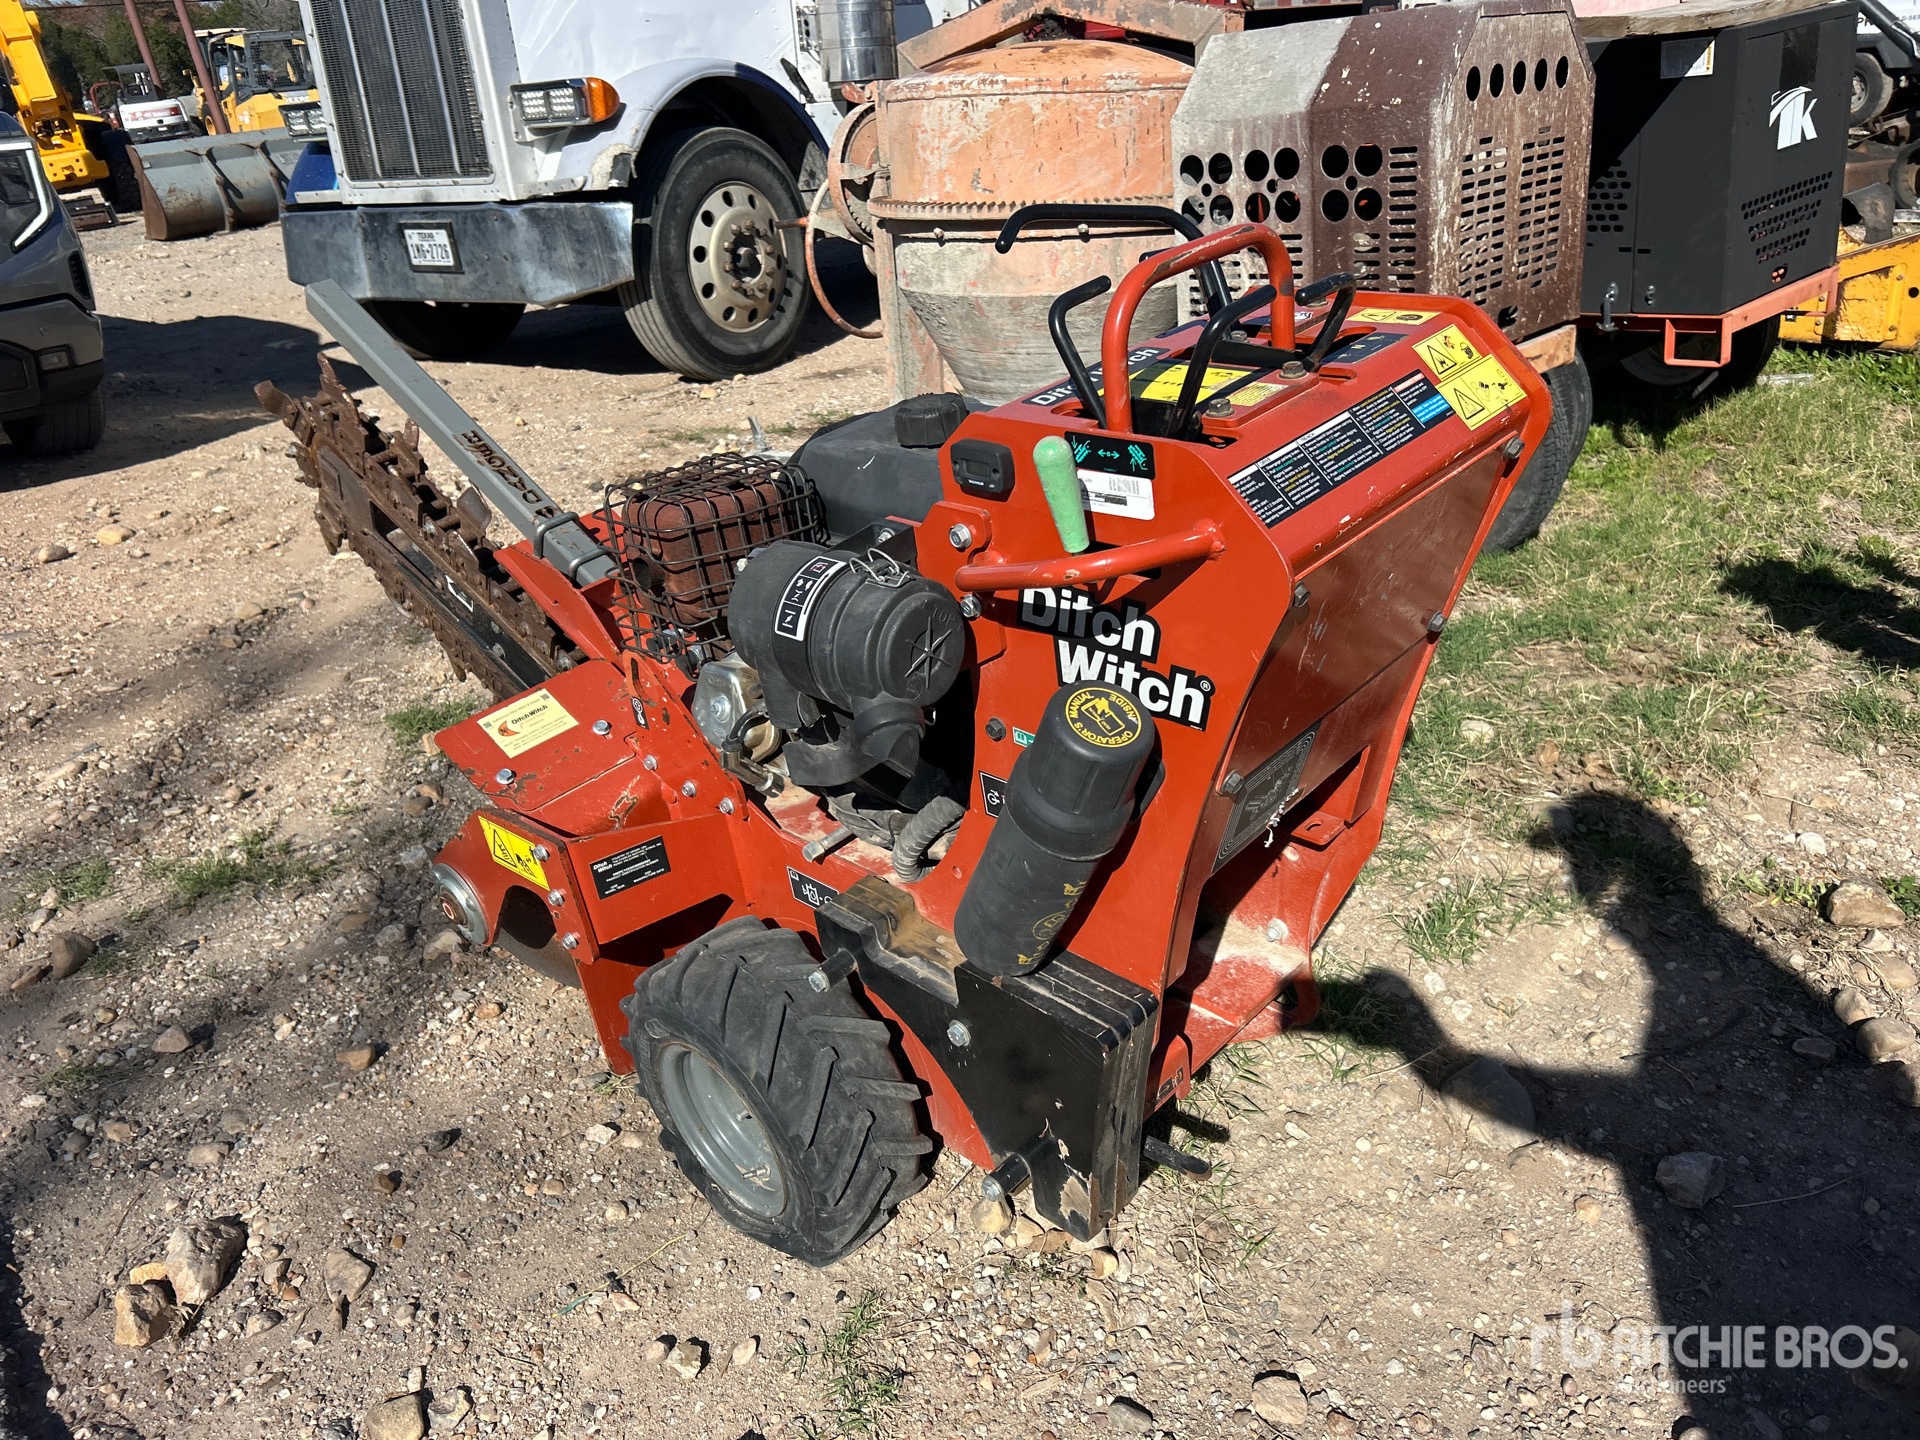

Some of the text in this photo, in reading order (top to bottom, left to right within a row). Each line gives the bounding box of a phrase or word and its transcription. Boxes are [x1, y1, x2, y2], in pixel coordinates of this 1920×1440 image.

[1021, 586, 1156, 657] Ditch
[1069, 691, 1094, 718] MANUAL
[1074, 721, 1133, 745] OPERATOR'S
